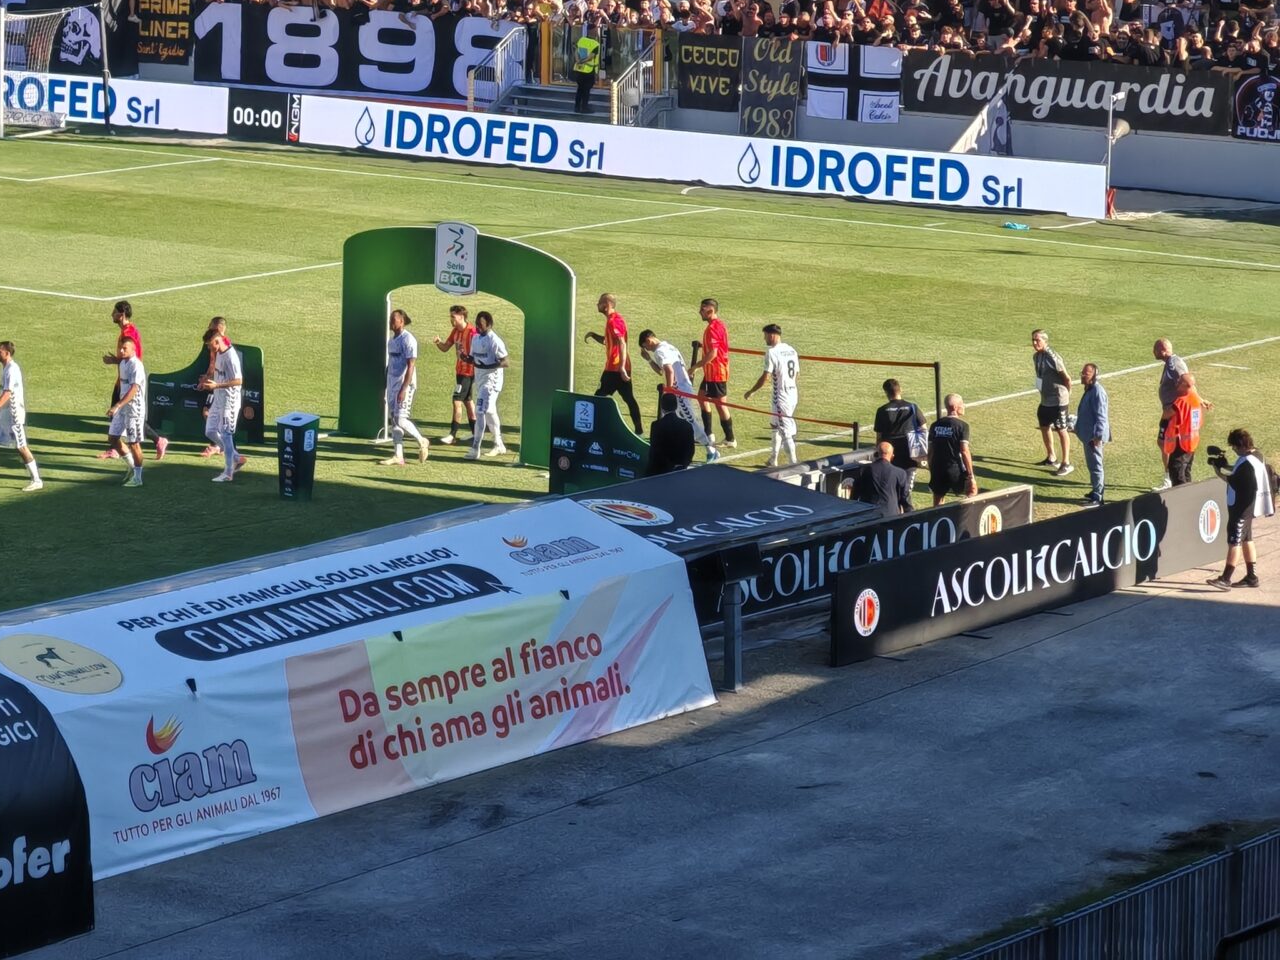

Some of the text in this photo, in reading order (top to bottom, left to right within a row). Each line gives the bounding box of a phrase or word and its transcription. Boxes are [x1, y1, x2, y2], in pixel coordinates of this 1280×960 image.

[138, 21, 190, 39] LINEA
[194, 2, 515, 102] 1898
[753, 37, 794, 63] Old
[689, 75, 731, 96] VIVE
[743, 69, 798, 102] Style
[914, 55, 1215, 119] Avanguardia
[126, 96, 160, 125] Srl
[232, 106, 282, 128] 00:00
[742, 106, 794, 138] 1983
[384, 108, 605, 171] IDROFED Srl
[771, 145, 1022, 208] IDROFED Srl
[439, 270, 472, 288] BKT
[446, 260, 466, 272] Serie
[787, 359, 796, 379] 8
[510, 536, 600, 565] ciam
[931, 518, 1157, 618] ASCOLI CALCIO
[117, 617, 163, 631] PER
[157, 606, 194, 625] CHI
[320, 567, 367, 587] SOLO
[388, 547, 459, 572] MEGLIO!
[184, 569, 479, 653] CIAMANIMALI.COM
[339, 632, 602, 723] Da sempre al fianco
[349, 662, 631, 770] di chi ama gli animali.
[129, 738, 257, 812] ciam
[113, 785, 282, 845] TUTTO PER GLI ANIMALI DAL 1967
